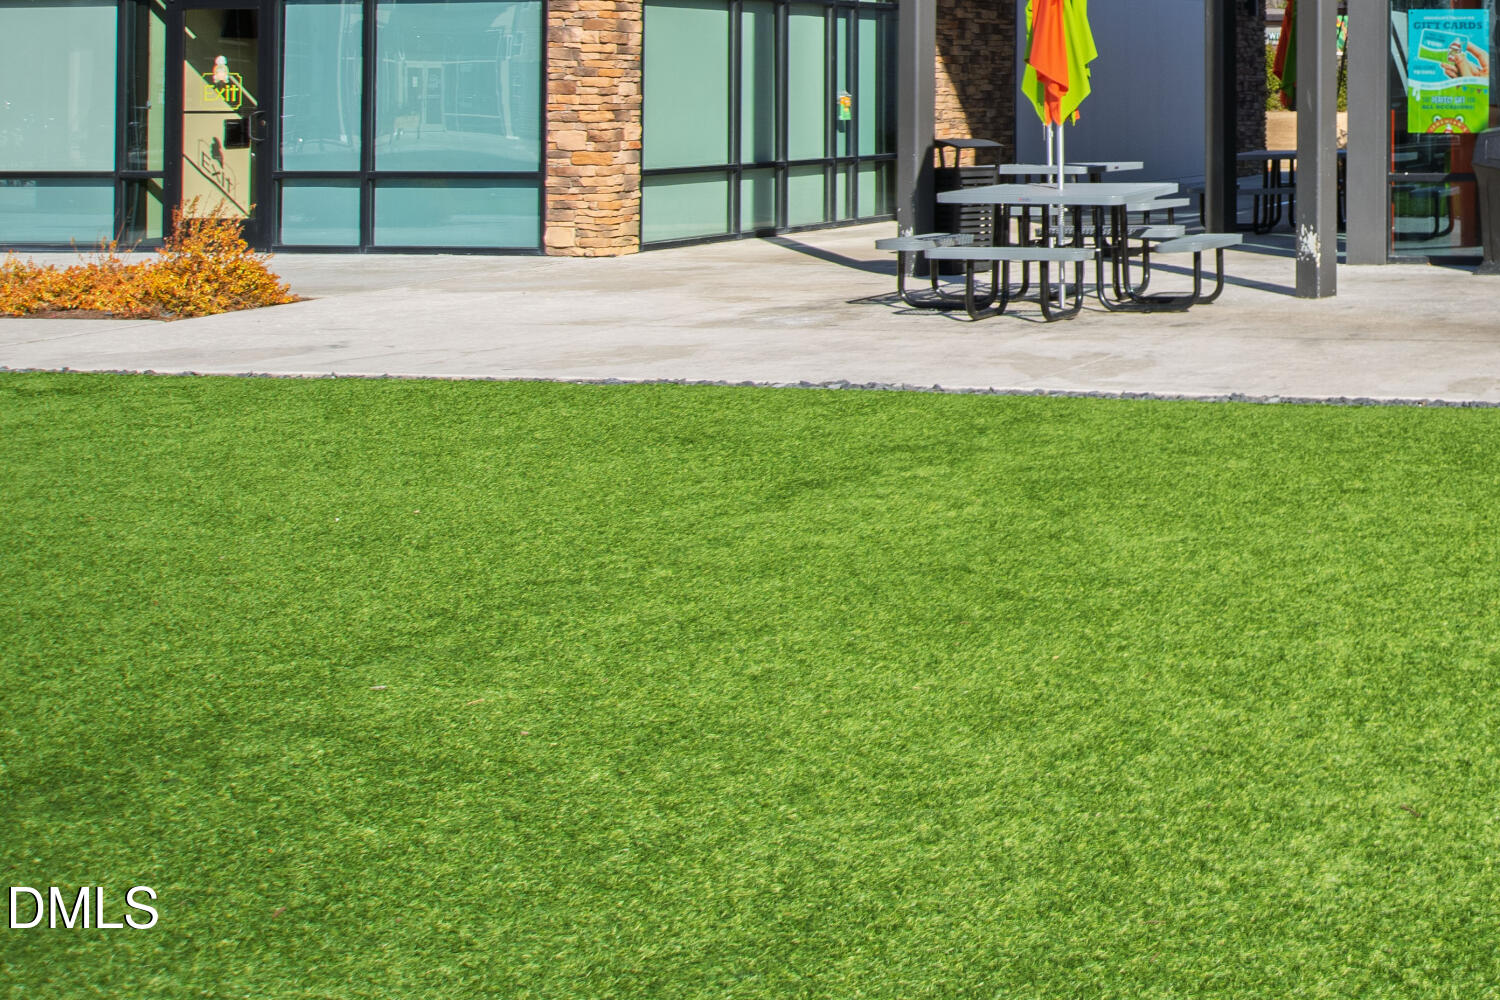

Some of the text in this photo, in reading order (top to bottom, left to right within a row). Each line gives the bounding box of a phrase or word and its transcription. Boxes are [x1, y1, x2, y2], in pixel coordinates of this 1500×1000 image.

[1414, 21, 1483, 30] GIFT CARDS
[204, 85, 239, 102] Exit
